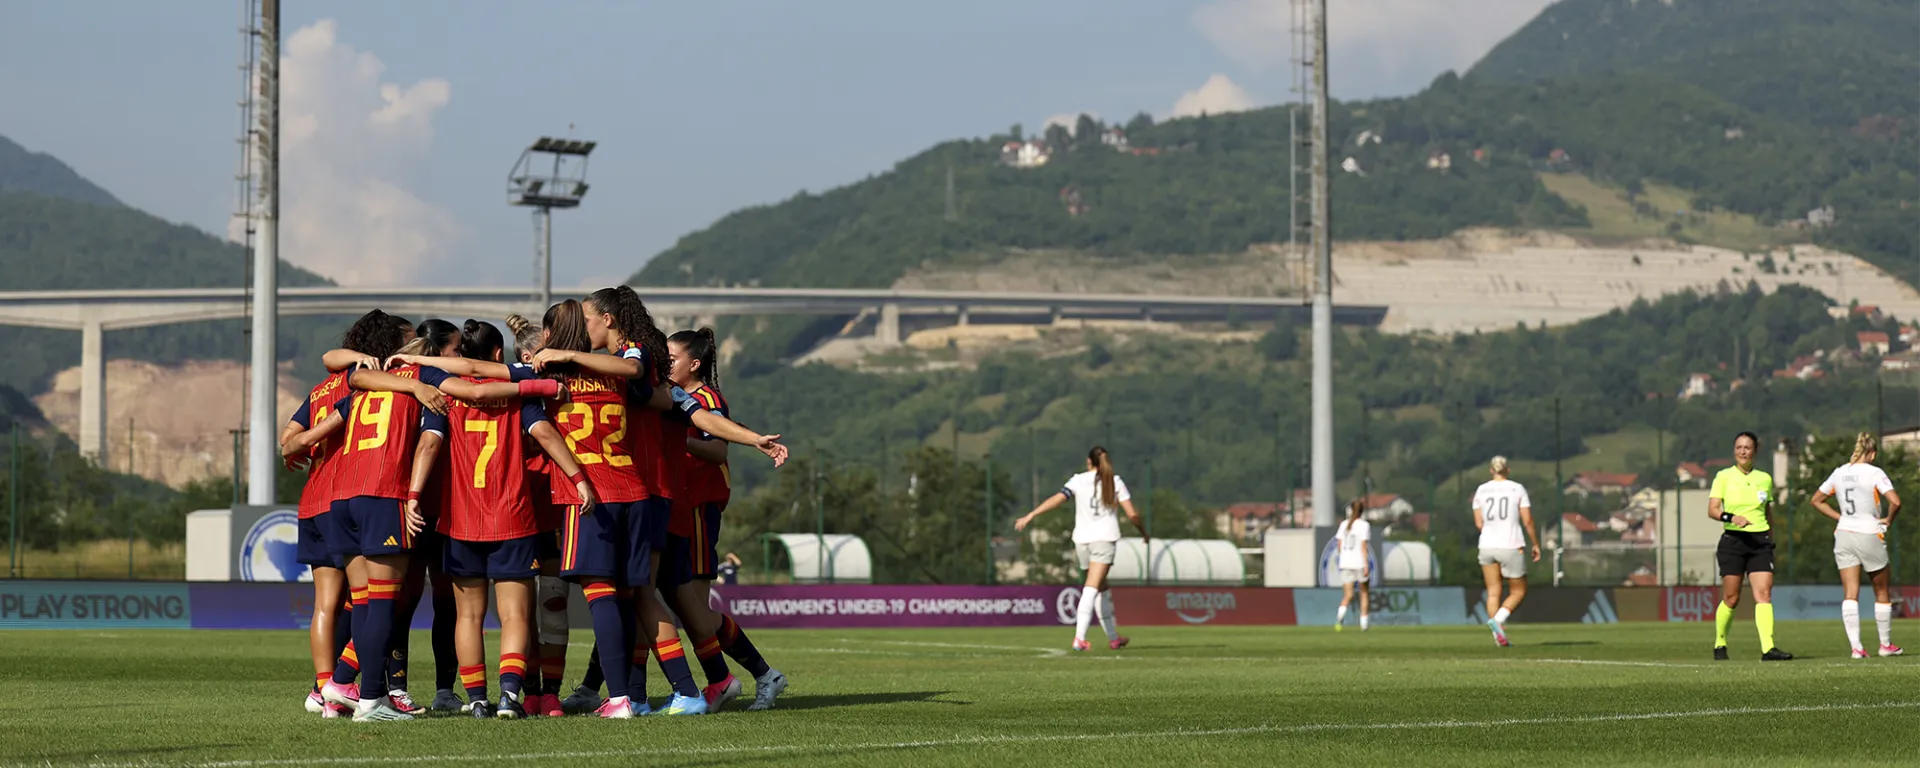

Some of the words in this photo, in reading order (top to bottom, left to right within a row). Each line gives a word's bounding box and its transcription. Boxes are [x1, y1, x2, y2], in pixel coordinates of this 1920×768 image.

[343, 391, 394, 455] 19
[558, 402, 633, 467] 22
[465, 420, 497, 488] 7
[1485, 496, 1509, 521] 20
[1845, 488, 1856, 515] 5
[1, 594, 66, 618] PLAY
[730, 599, 767, 616] UEFA
[768, 599, 836, 616] WOMEN'S
[838, 599, 905, 616] UNDER-19
[908, 598, 1011, 615] CHAMPIONSHIP
[1011, 598, 1046, 615] 2026
[1165, 592, 1237, 610] amazon
